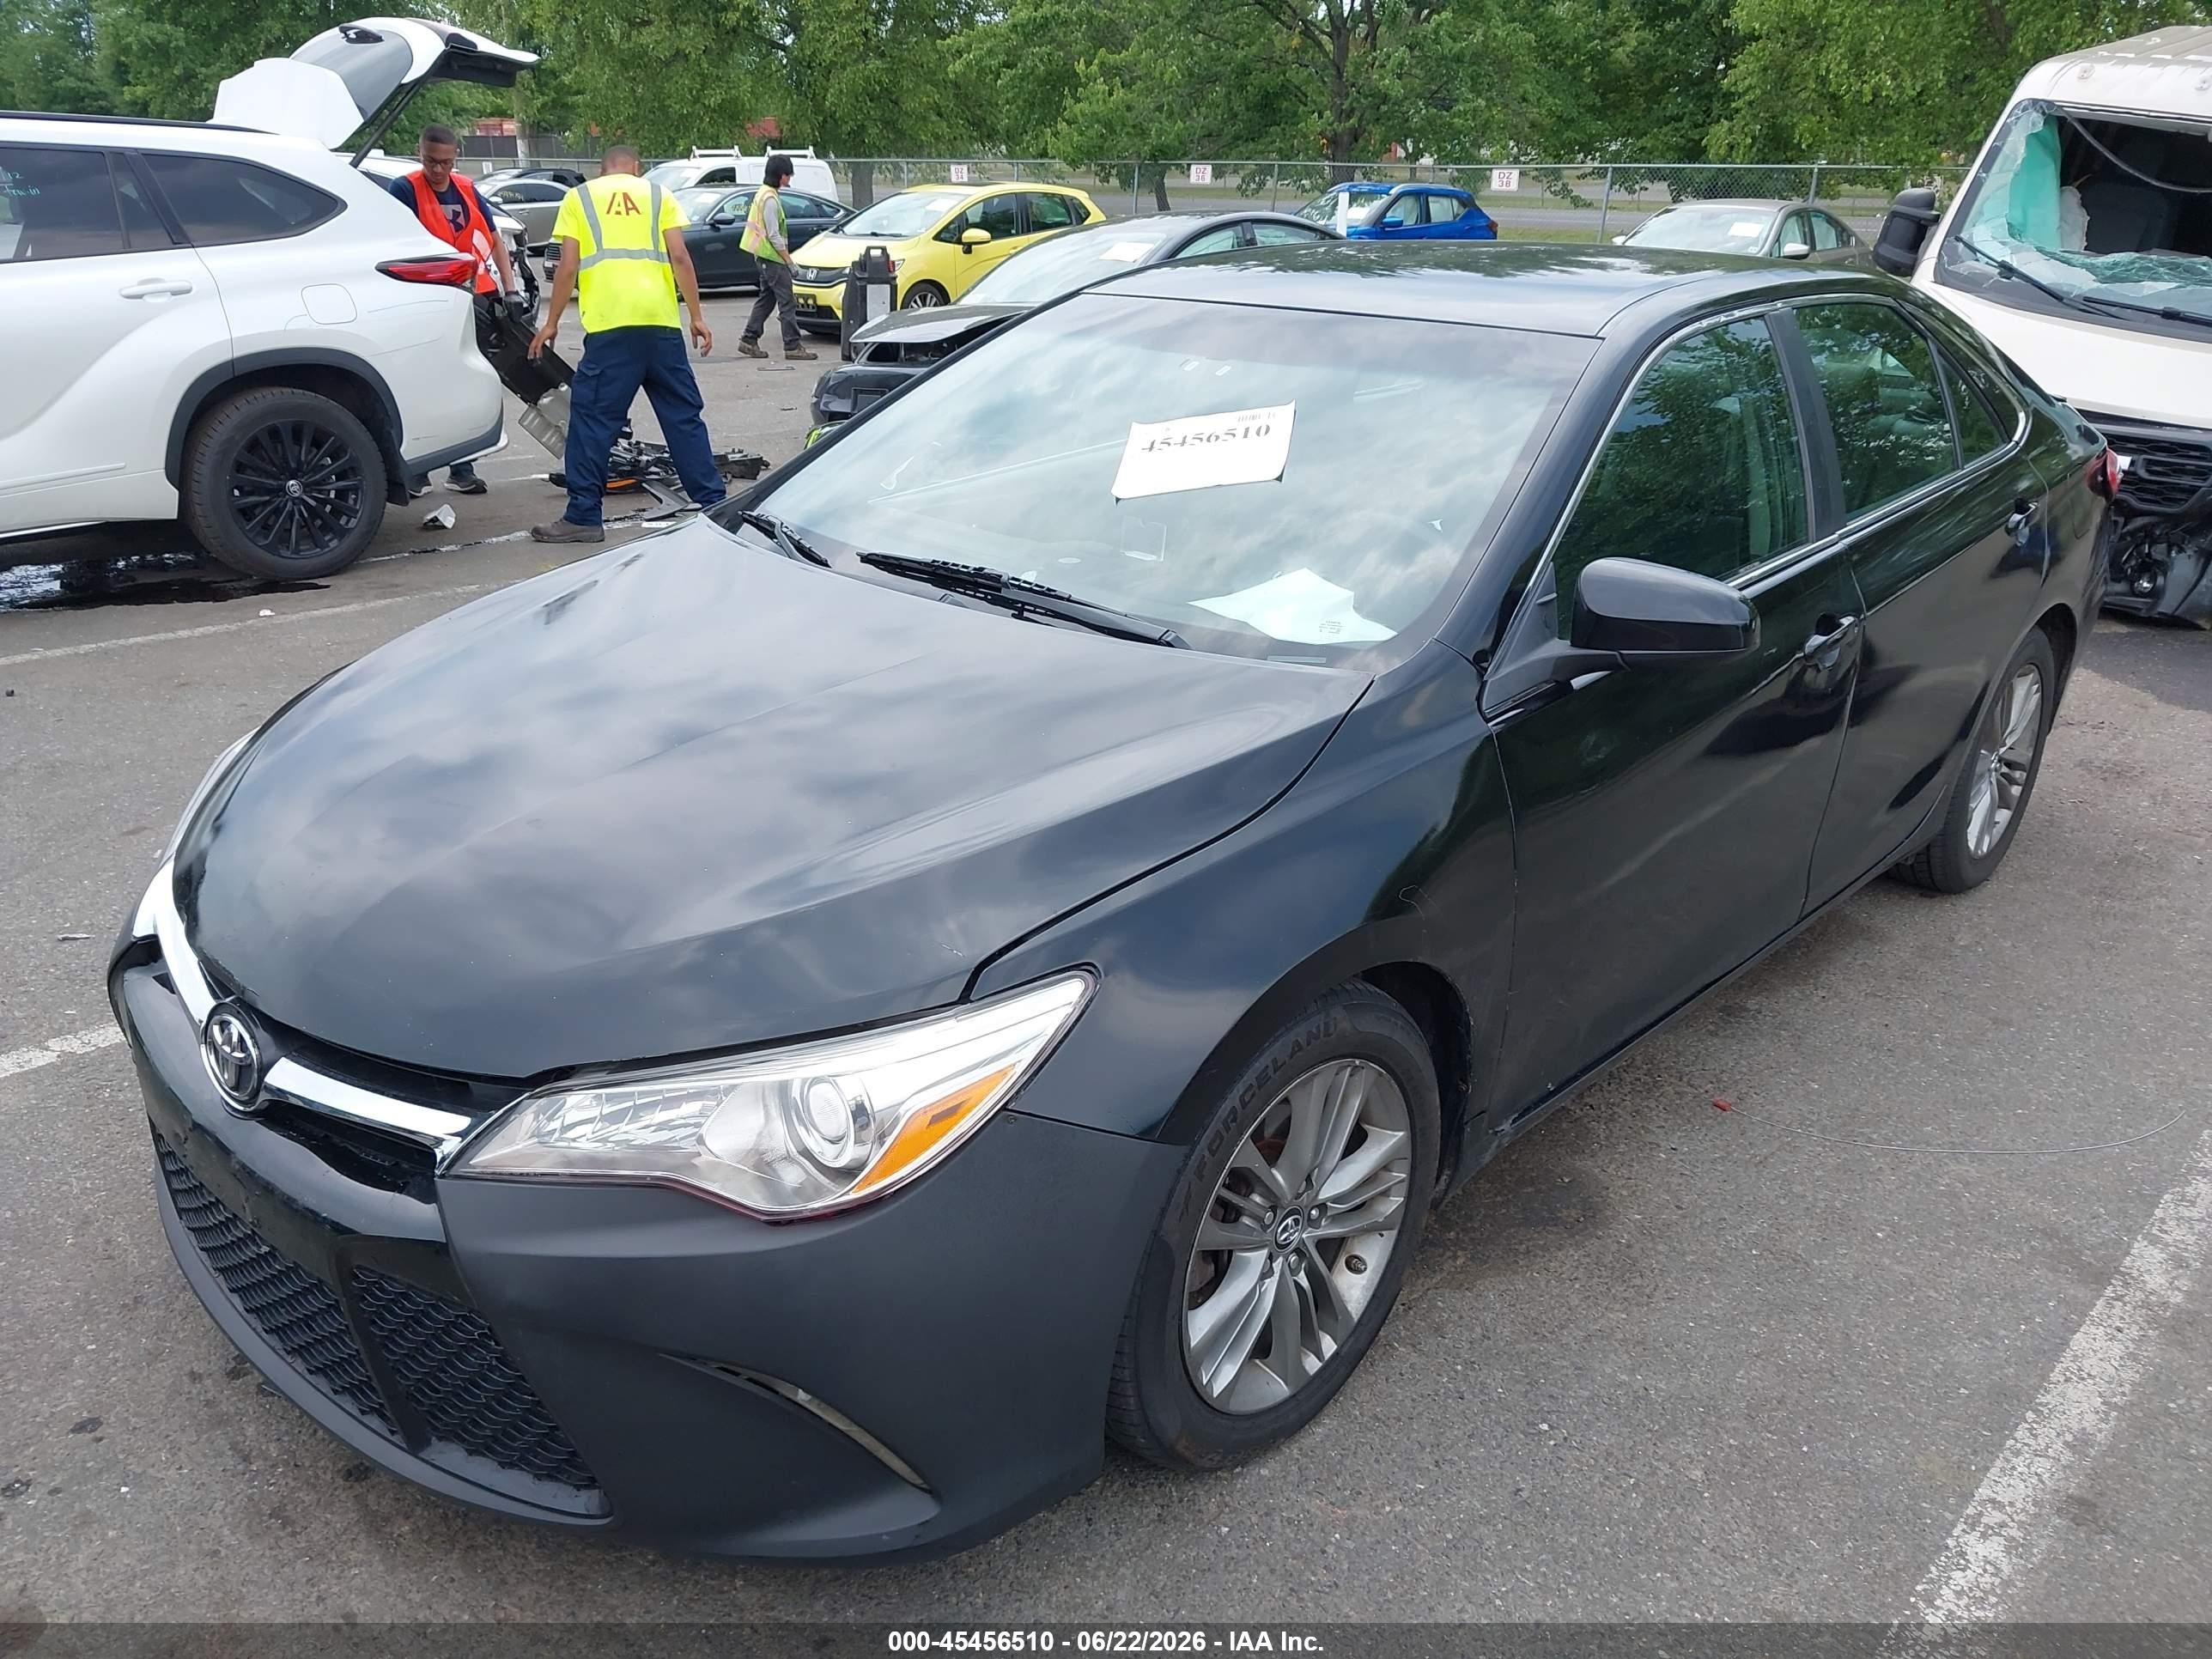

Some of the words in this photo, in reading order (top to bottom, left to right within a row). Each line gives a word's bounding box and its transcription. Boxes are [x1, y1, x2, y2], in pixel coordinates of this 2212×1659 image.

[1195, 167, 1207, 175] DZ
[1498, 171, 1512, 179] DZ
[1498, 179, 1511, 188] 38
[1140, 423, 1271, 453] 45456510
[1194, 1016, 1338, 1183] FORCELAND
